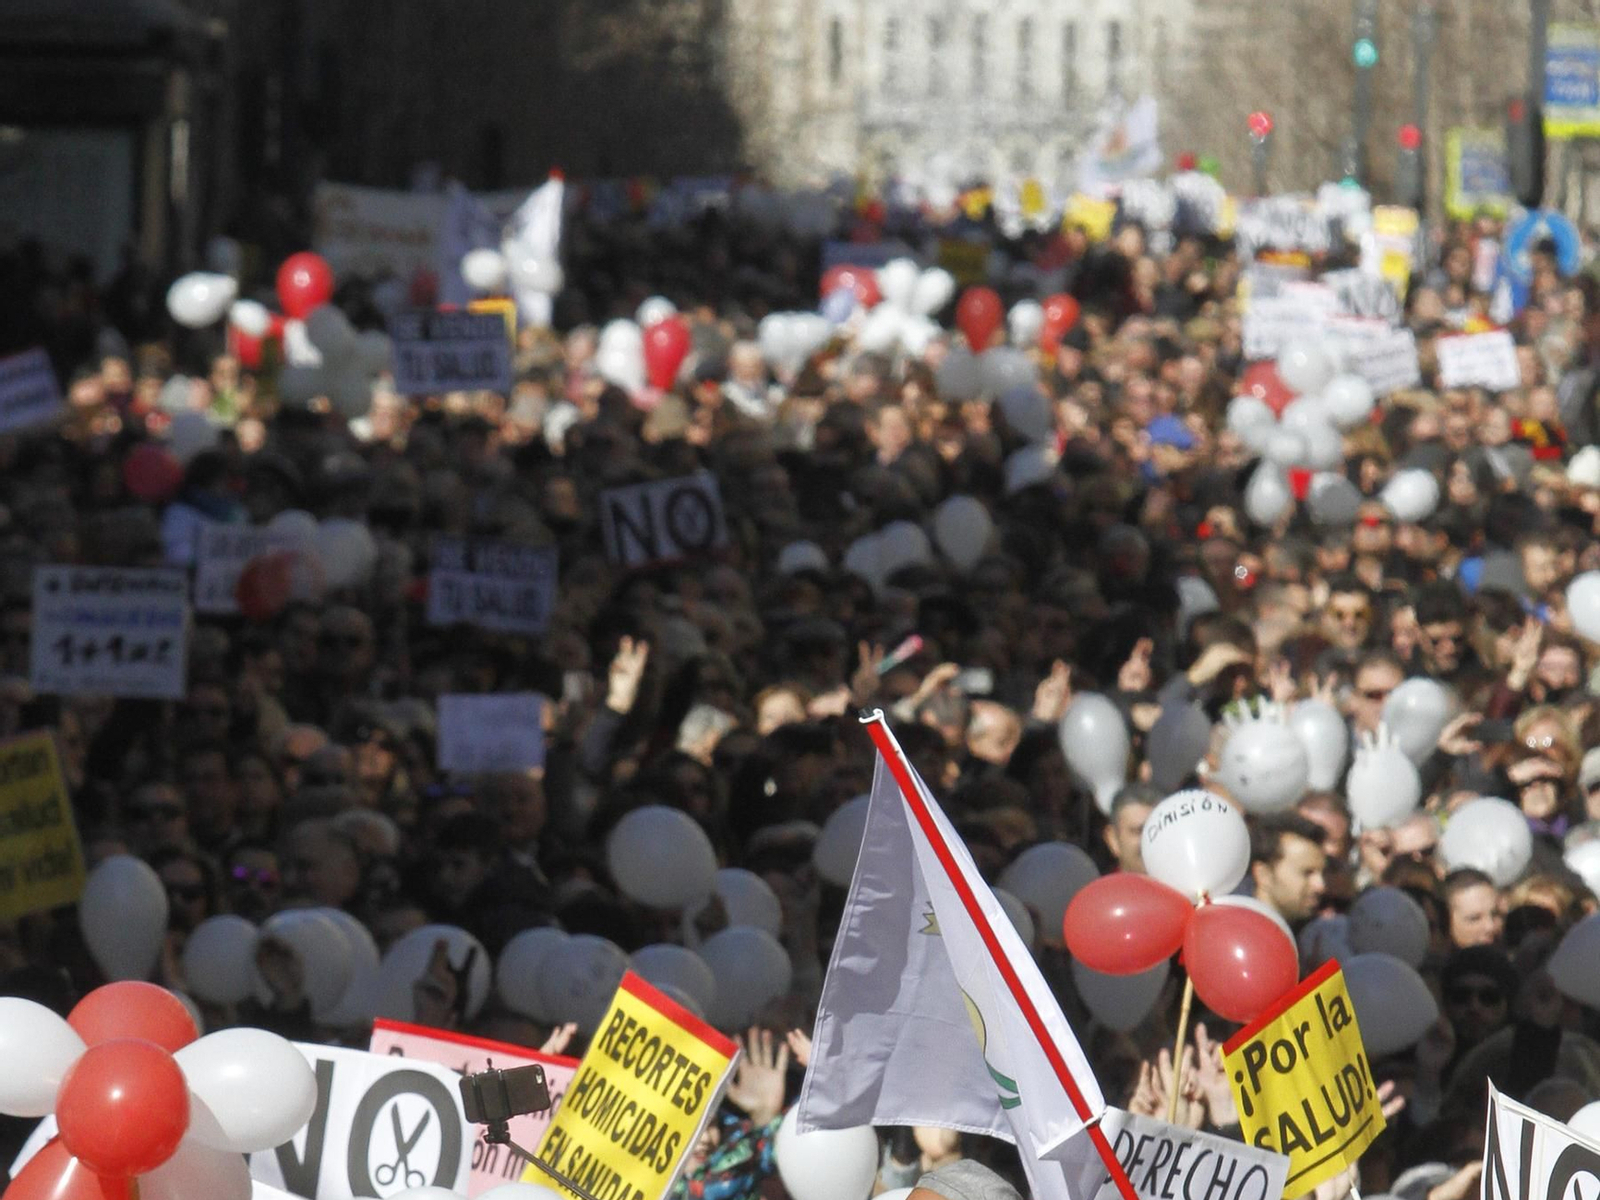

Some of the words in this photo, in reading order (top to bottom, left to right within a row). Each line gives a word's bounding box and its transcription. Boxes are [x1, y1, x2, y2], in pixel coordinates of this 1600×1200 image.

[608, 484, 716, 560] NO
[598, 1008, 712, 1117] RECORTES
[1235, 1020, 1311, 1117] ¡Por
[1315, 992, 1352, 1039] la
[1254, 1053, 1373, 1156] SALUD!
[538, 1125, 567, 1172] EN
[567, 1066, 682, 1175] HOMICIDAS
